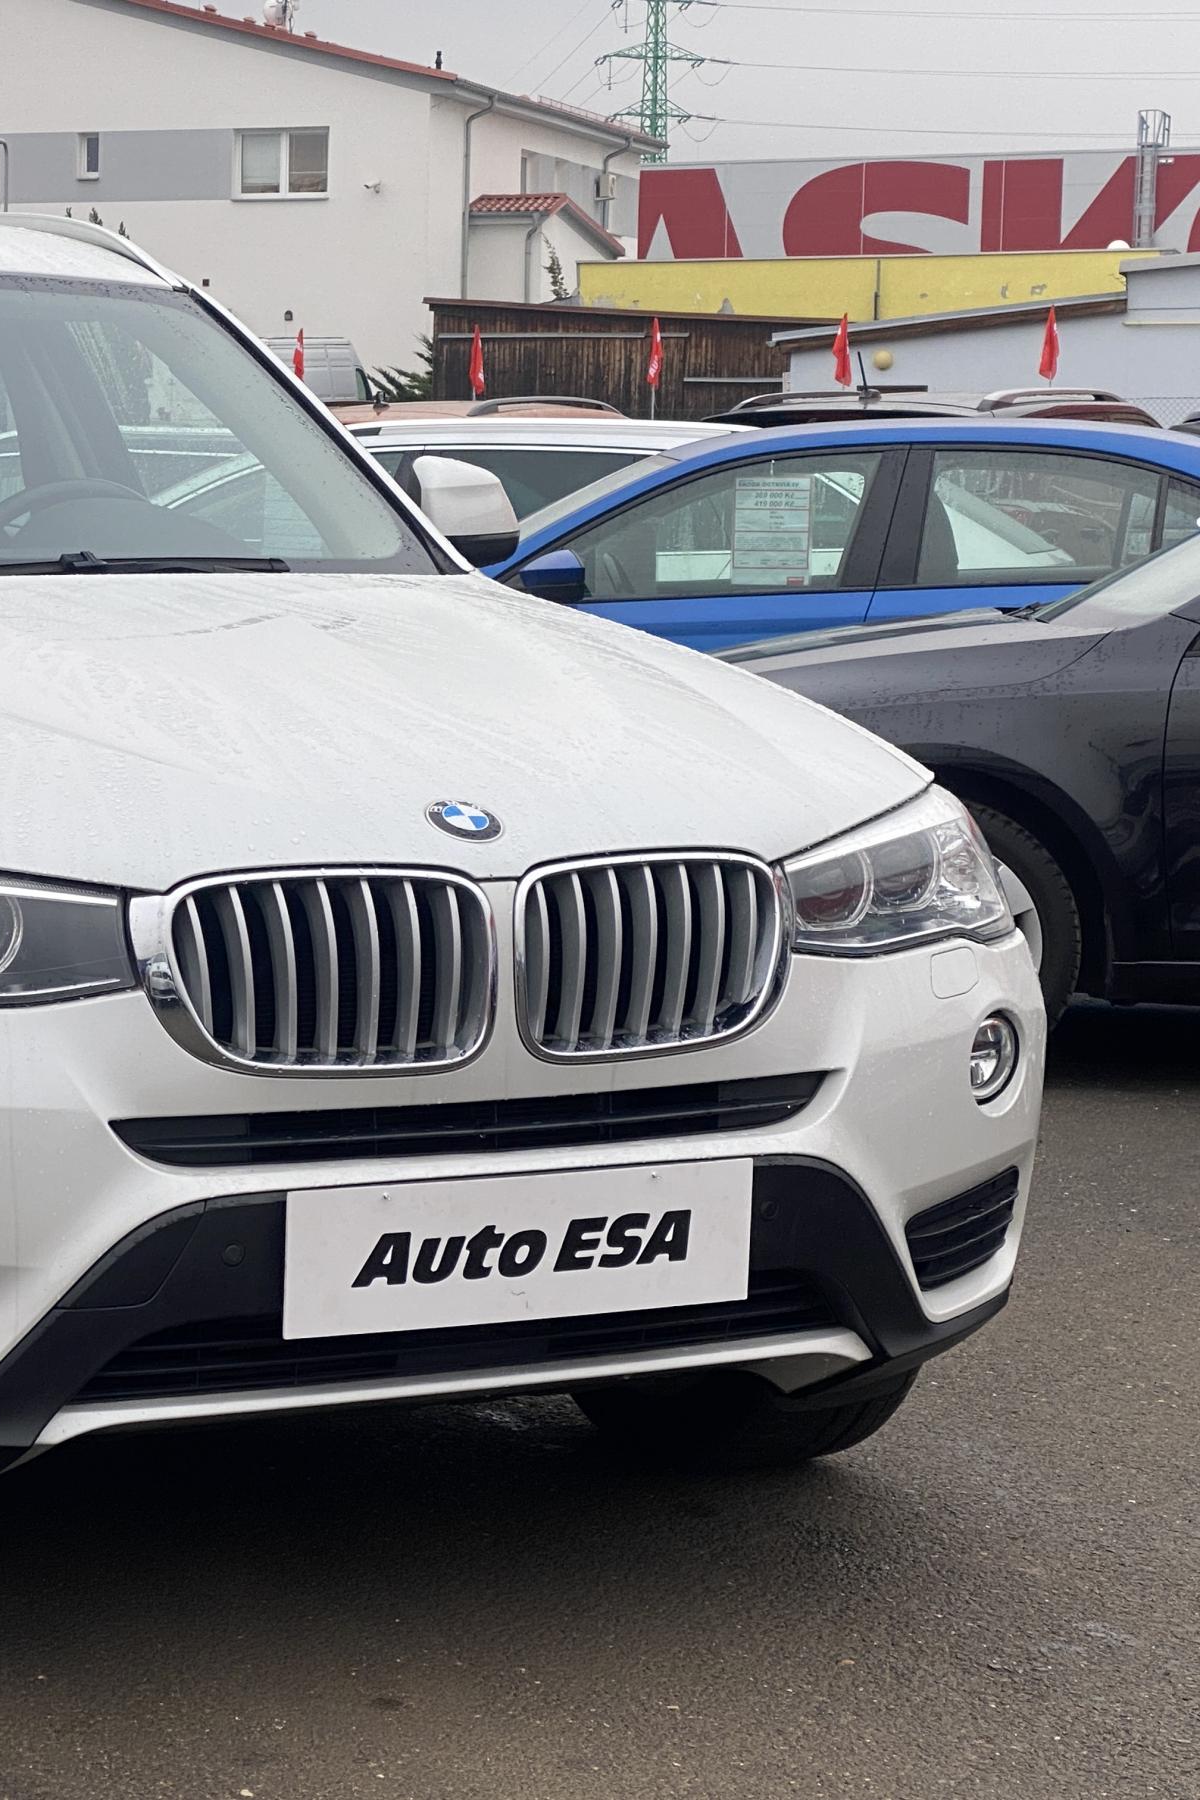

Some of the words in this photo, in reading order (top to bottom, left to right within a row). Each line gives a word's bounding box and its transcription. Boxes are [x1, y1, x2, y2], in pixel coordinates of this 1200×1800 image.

[637, 154, 1200, 259] ASK
[352, 1225, 547, 1287] Auto
[553, 1210, 691, 1272] ESA
